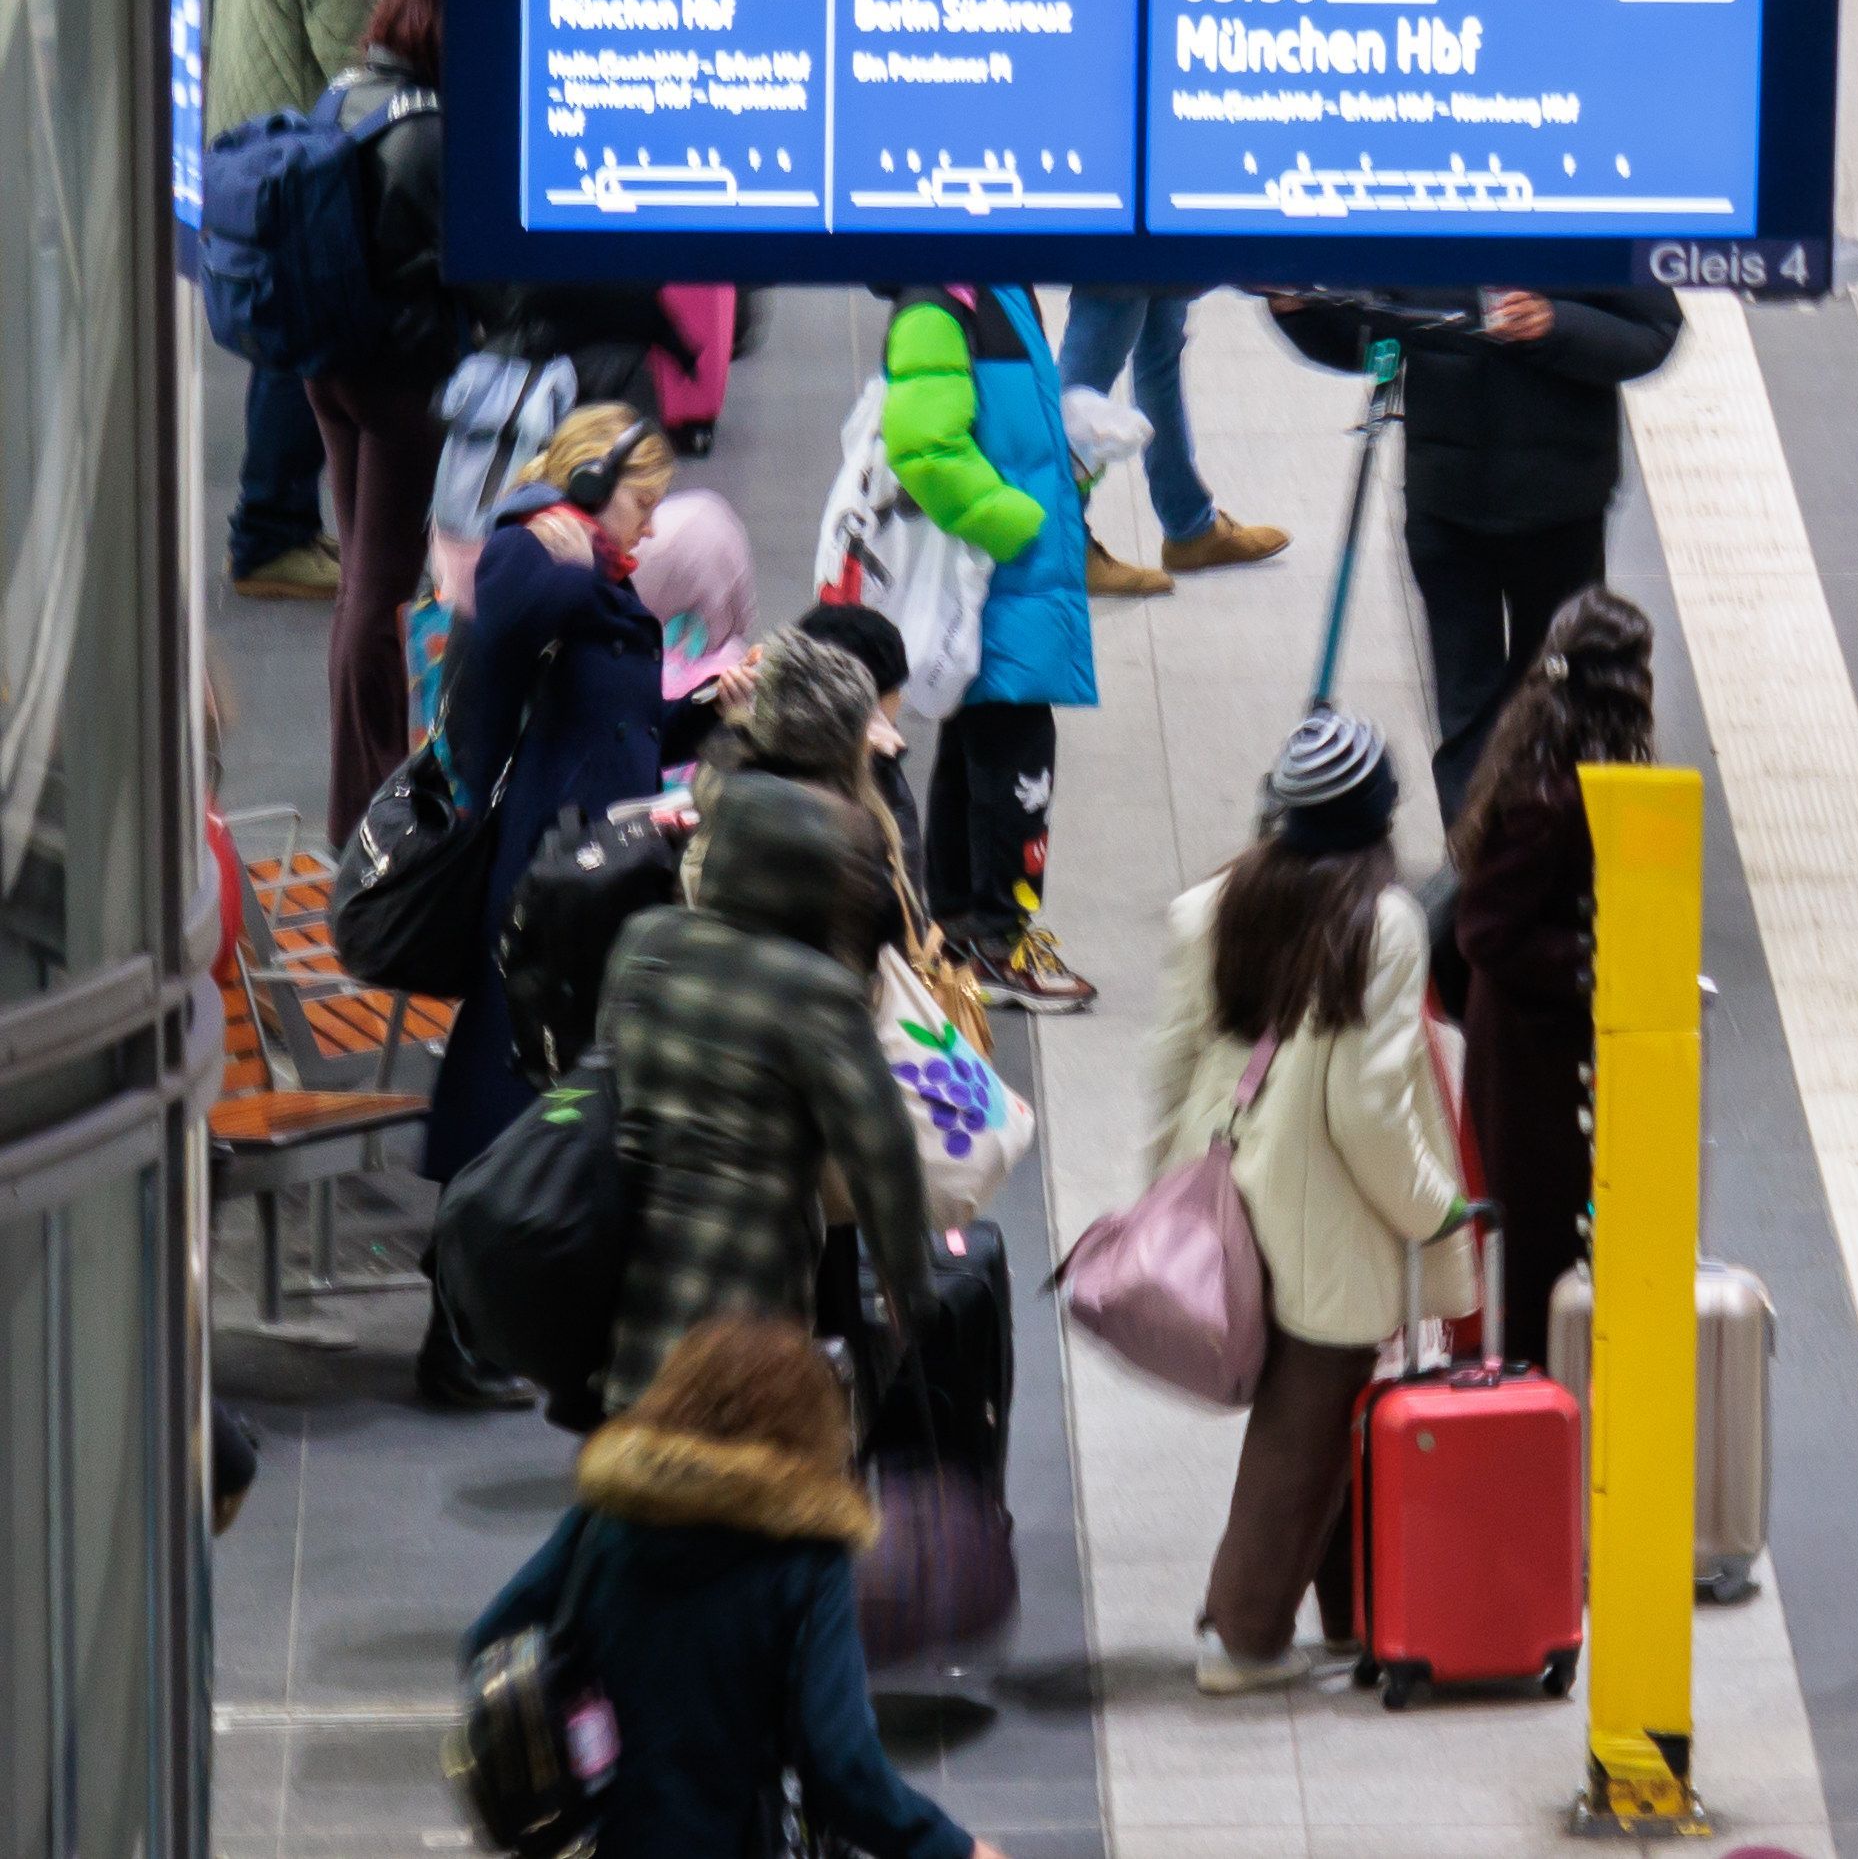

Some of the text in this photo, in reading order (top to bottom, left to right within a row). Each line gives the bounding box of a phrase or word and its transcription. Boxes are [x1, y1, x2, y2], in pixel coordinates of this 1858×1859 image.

[1176, 14, 1483, 75] München Hbf
[1650, 241, 1809, 287] Gleis 4
